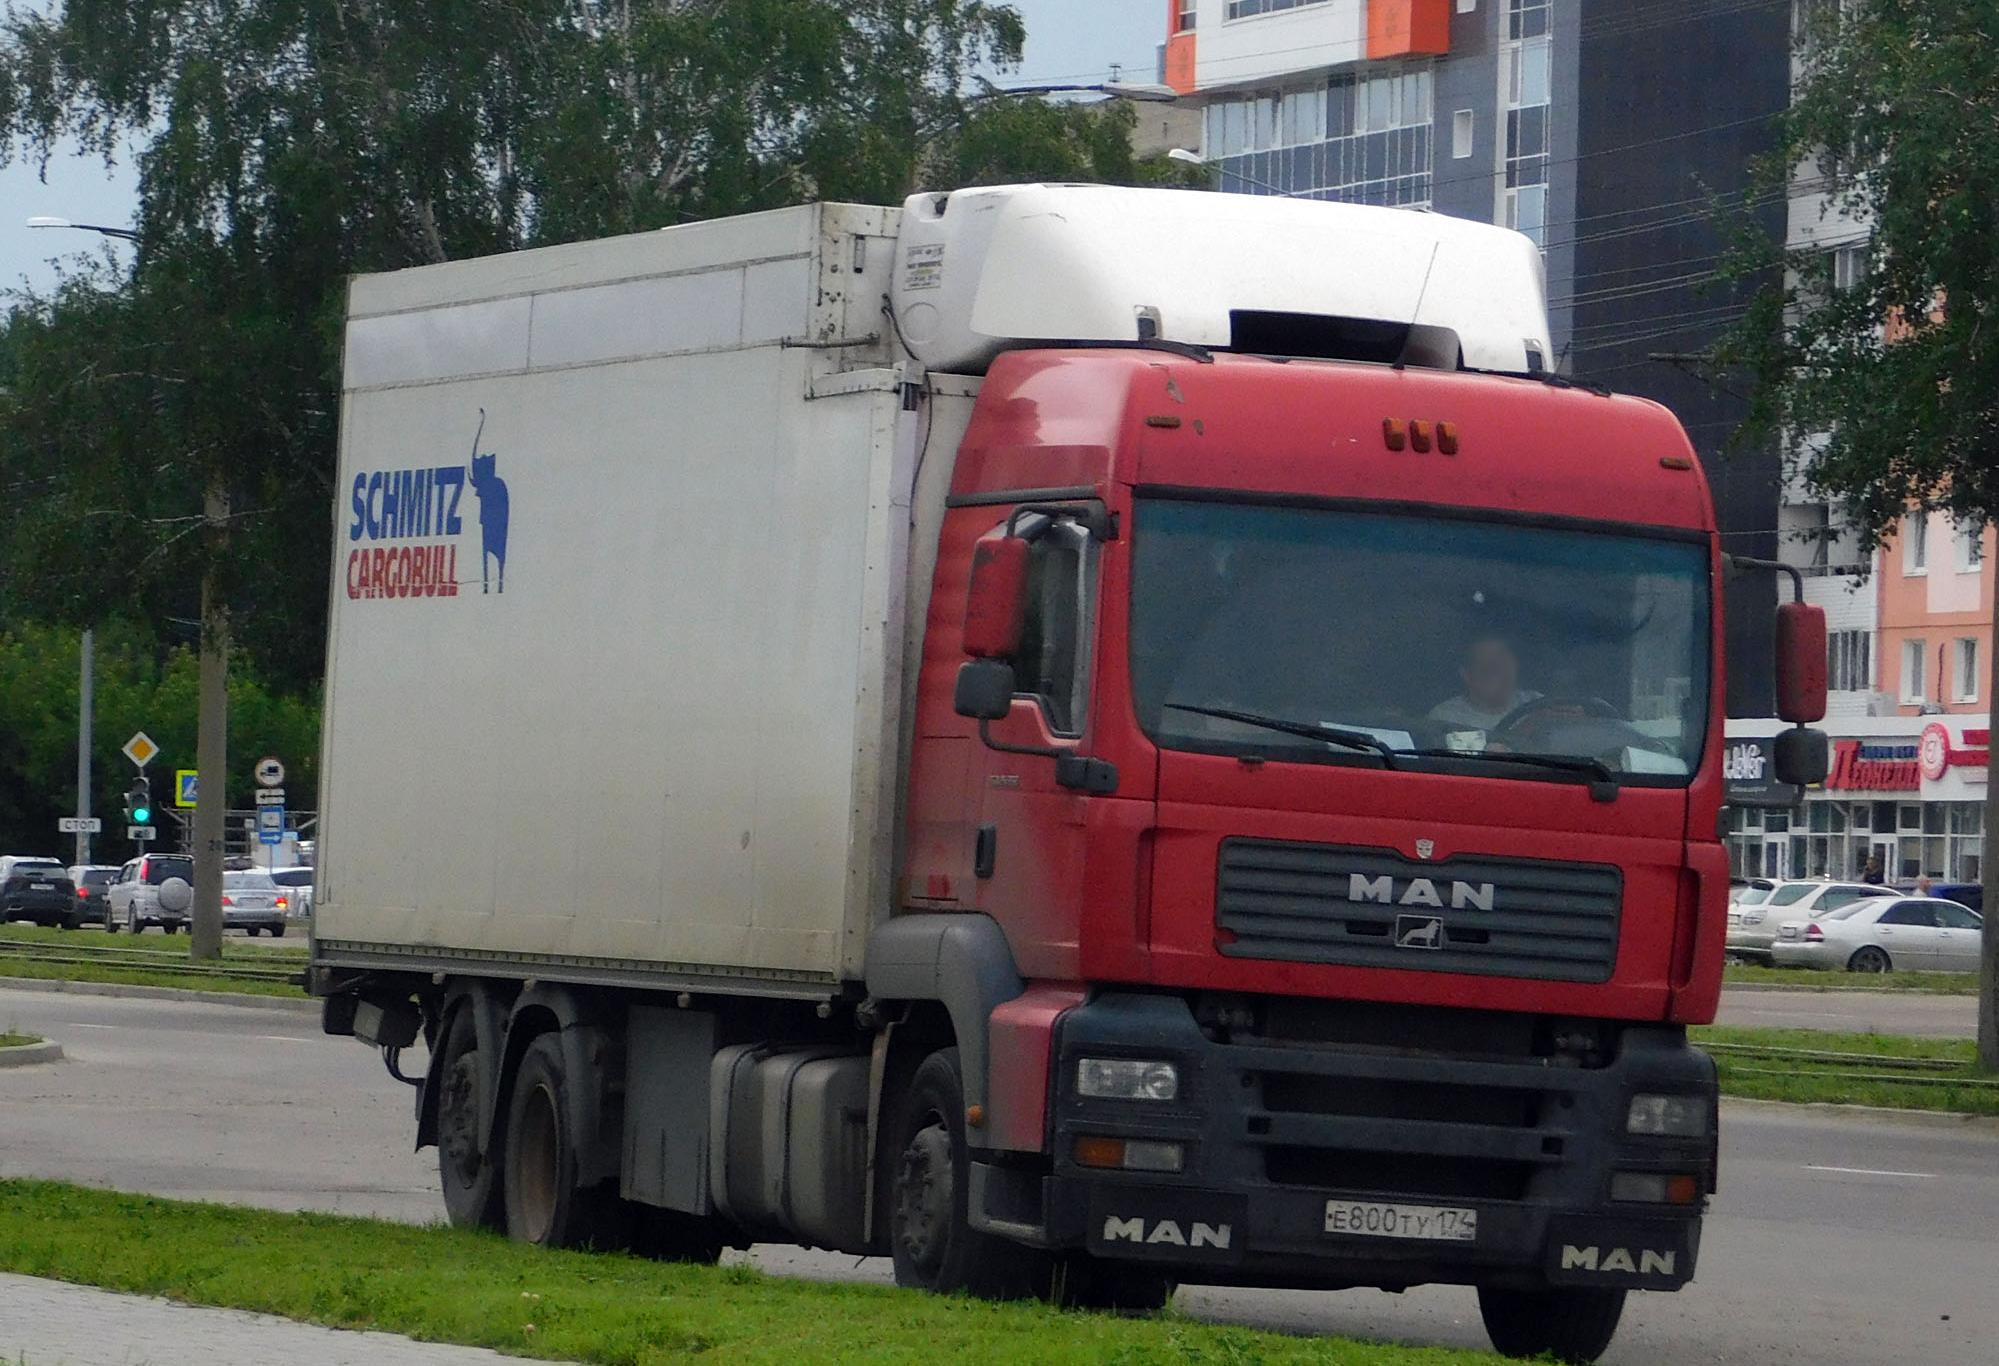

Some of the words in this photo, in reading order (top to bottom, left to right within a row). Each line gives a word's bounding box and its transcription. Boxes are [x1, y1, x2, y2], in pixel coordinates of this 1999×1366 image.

[350, 466, 466, 541] SCHMITZ
[346, 544, 459, 600] CARGOBULL
[64, 820, 96, 830] СТОП
[1348, 873, 1495, 911] MAN
[1104, 1215, 1231, 1249] MAN
[1561, 1245, 1676, 1275] MAN
